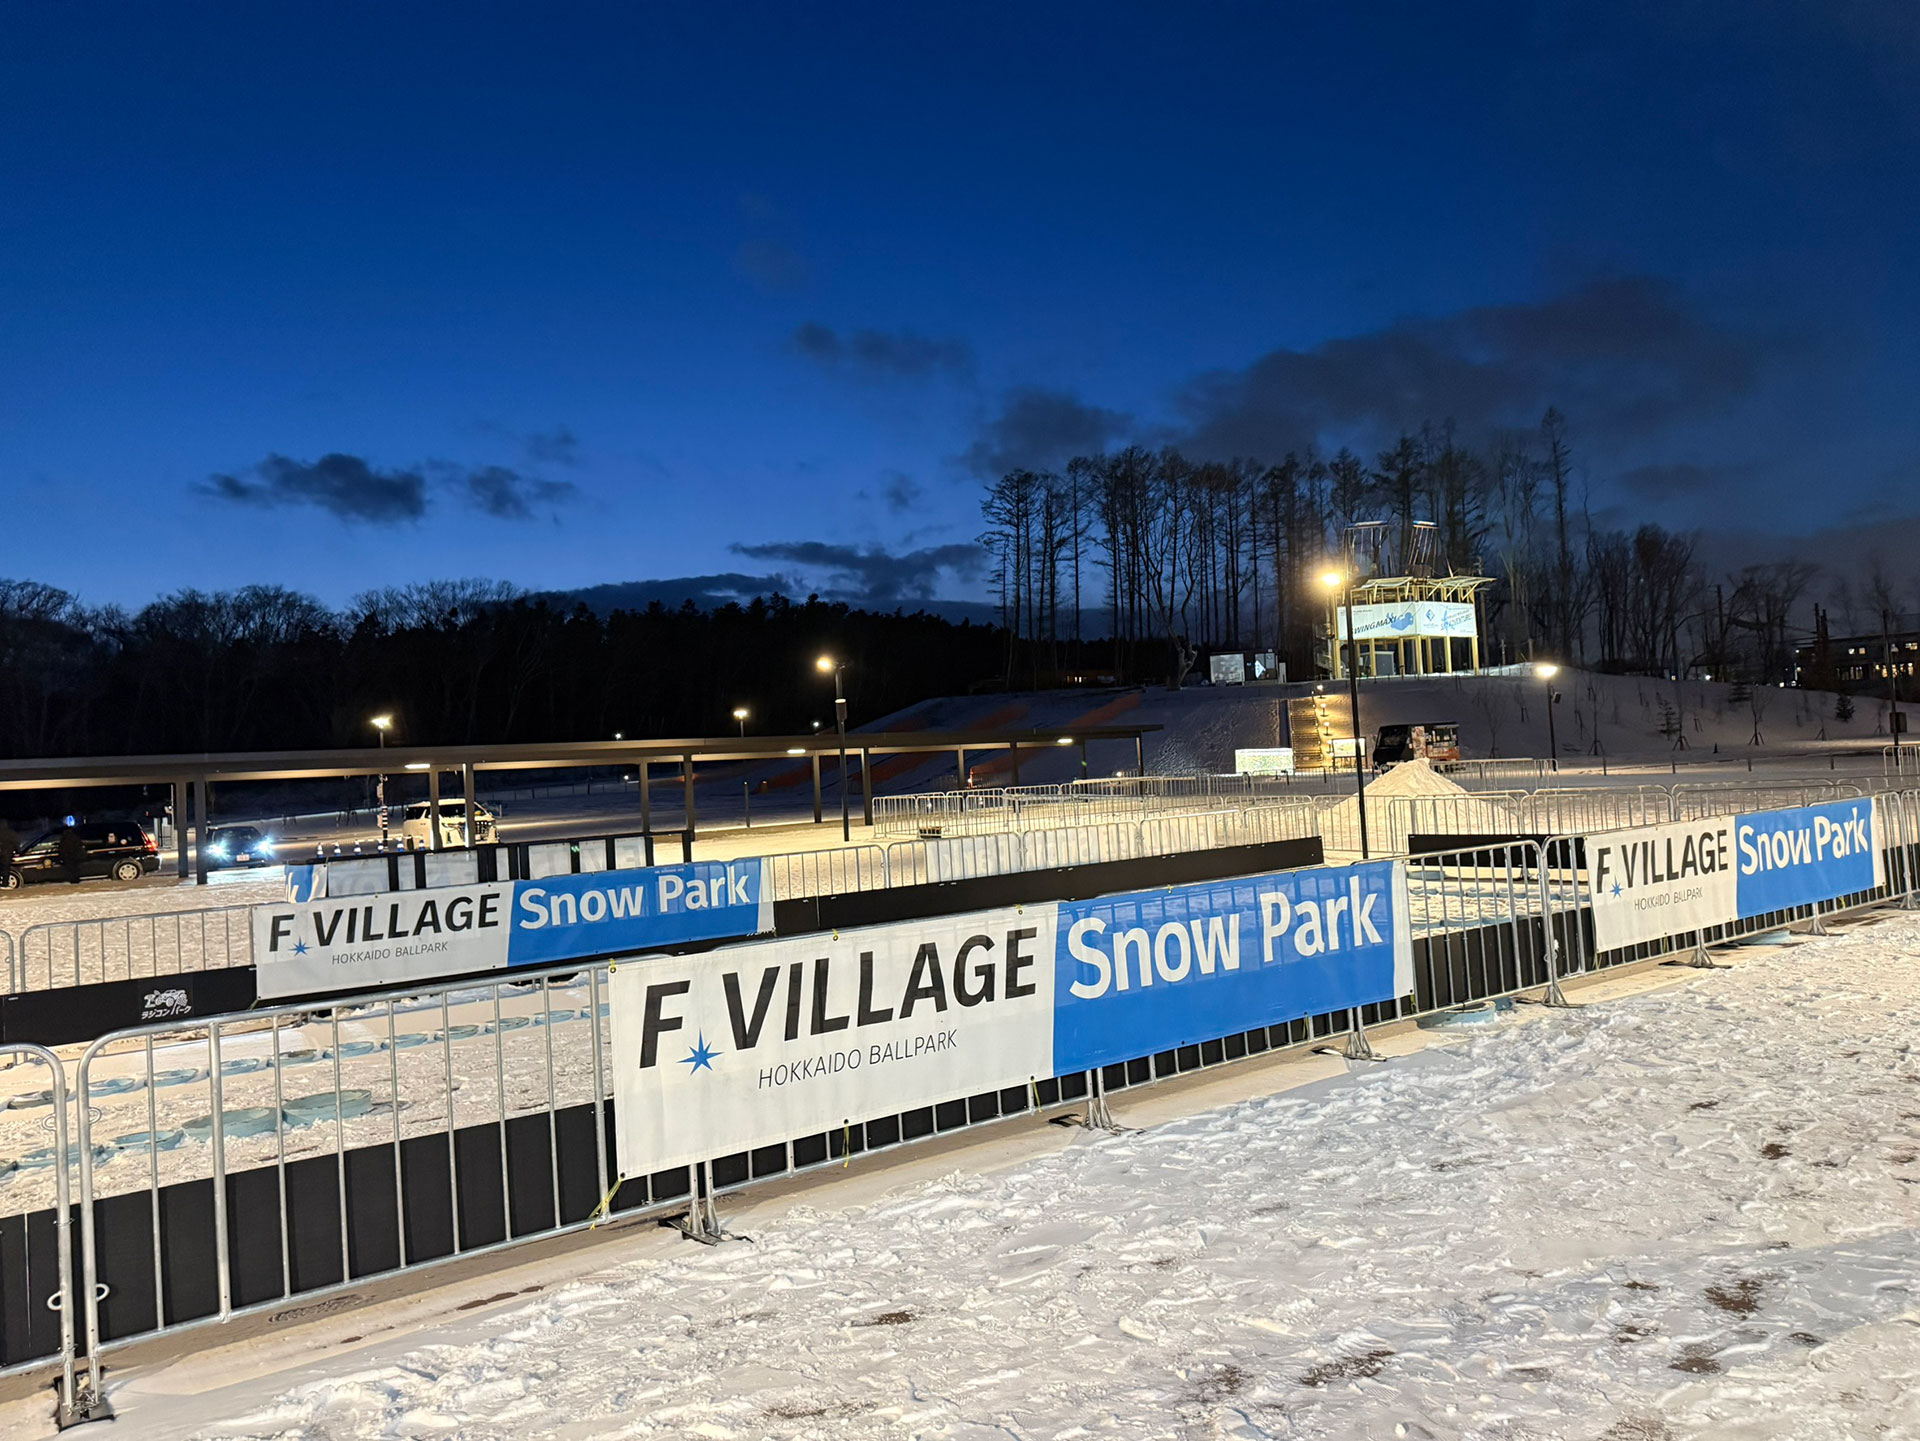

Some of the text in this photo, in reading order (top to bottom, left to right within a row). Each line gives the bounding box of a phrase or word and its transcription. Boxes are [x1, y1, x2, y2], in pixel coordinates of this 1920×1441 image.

[1597, 829, 1728, 893] F VILLAGE
[1739, 807, 1868, 875] Snow Park
[269, 893, 500, 952] F VILLAGE
[519, 865, 750, 929] Snow Park
[1635, 887, 1702, 911] HOKKAIDO BALLPARK
[332, 941, 448, 965] HOKKAIDO BALLPARK
[1068, 875, 1383, 1000] Snow Park
[639, 927, 1038, 1069] F VILLAGE
[759, 1029, 957, 1089] HOKKAIDO BALLPARK
